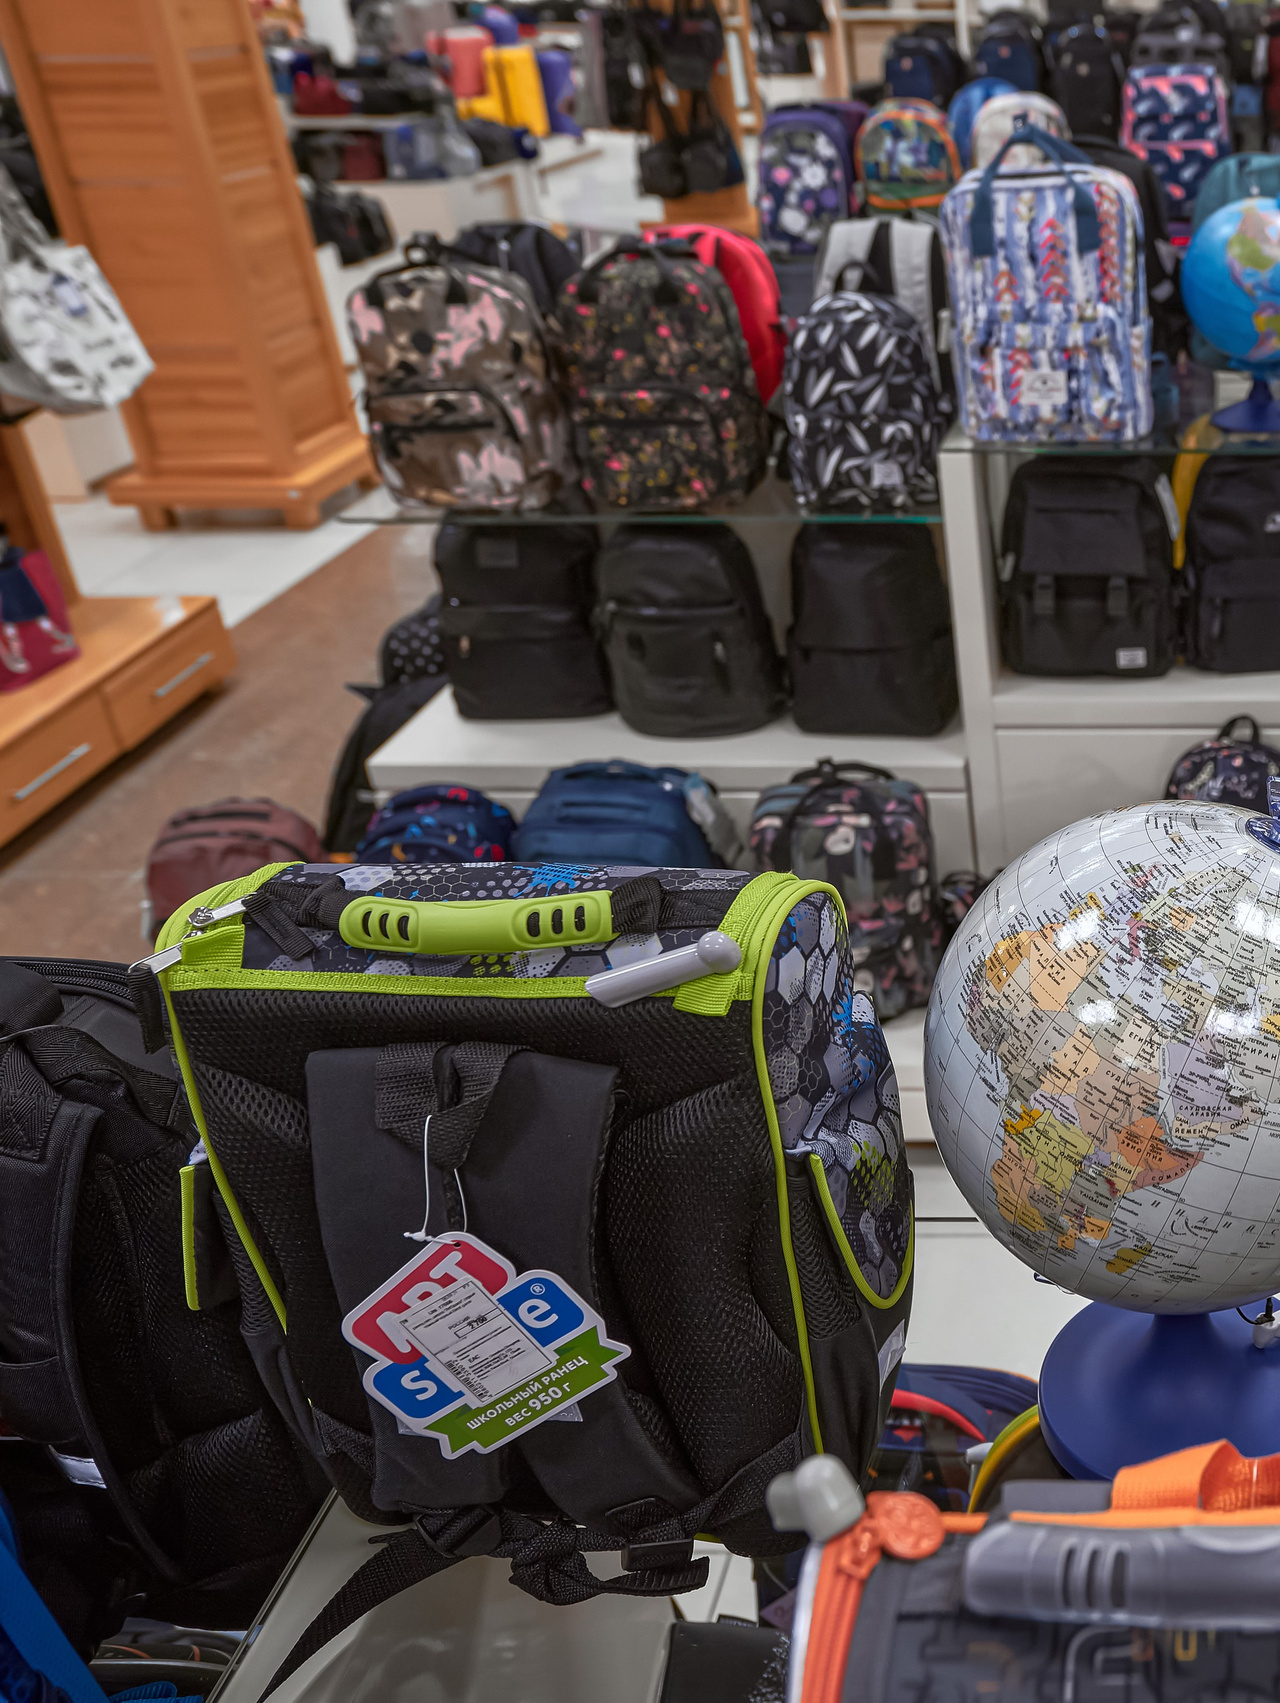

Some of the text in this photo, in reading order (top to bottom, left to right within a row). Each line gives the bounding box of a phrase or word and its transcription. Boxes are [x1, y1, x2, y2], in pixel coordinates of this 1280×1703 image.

[1171, 985, 1205, 1006] ТУРЦИЯ
[1129, 1031, 1161, 1052] ЕГИПЕТ
[1248, 1038, 1269, 1047] ТЕГЕРАН
[1251, 1048, 1277, 1060] ИРАН
[1106, 1070, 1132, 1088] СУДАН
[1175, 1116, 1188, 1124] САНА
[1230, 1117, 1250, 1130] ОМАН
[1111, 1162, 1132, 1175] КЕНИЯ
[1151, 1163, 1190, 1181] СОМАЛИ
[1079, 1190, 1108, 1209] ТАНЗАНИЯ
[468, 1354, 480, 1363] EAC
[466, 1377, 543, 1430] ШКОЛЬНЫЙ
[542, 1356, 589, 1387] РАНЕЦ
[505, 1382, 572, 1427] ВЕС 950 г
